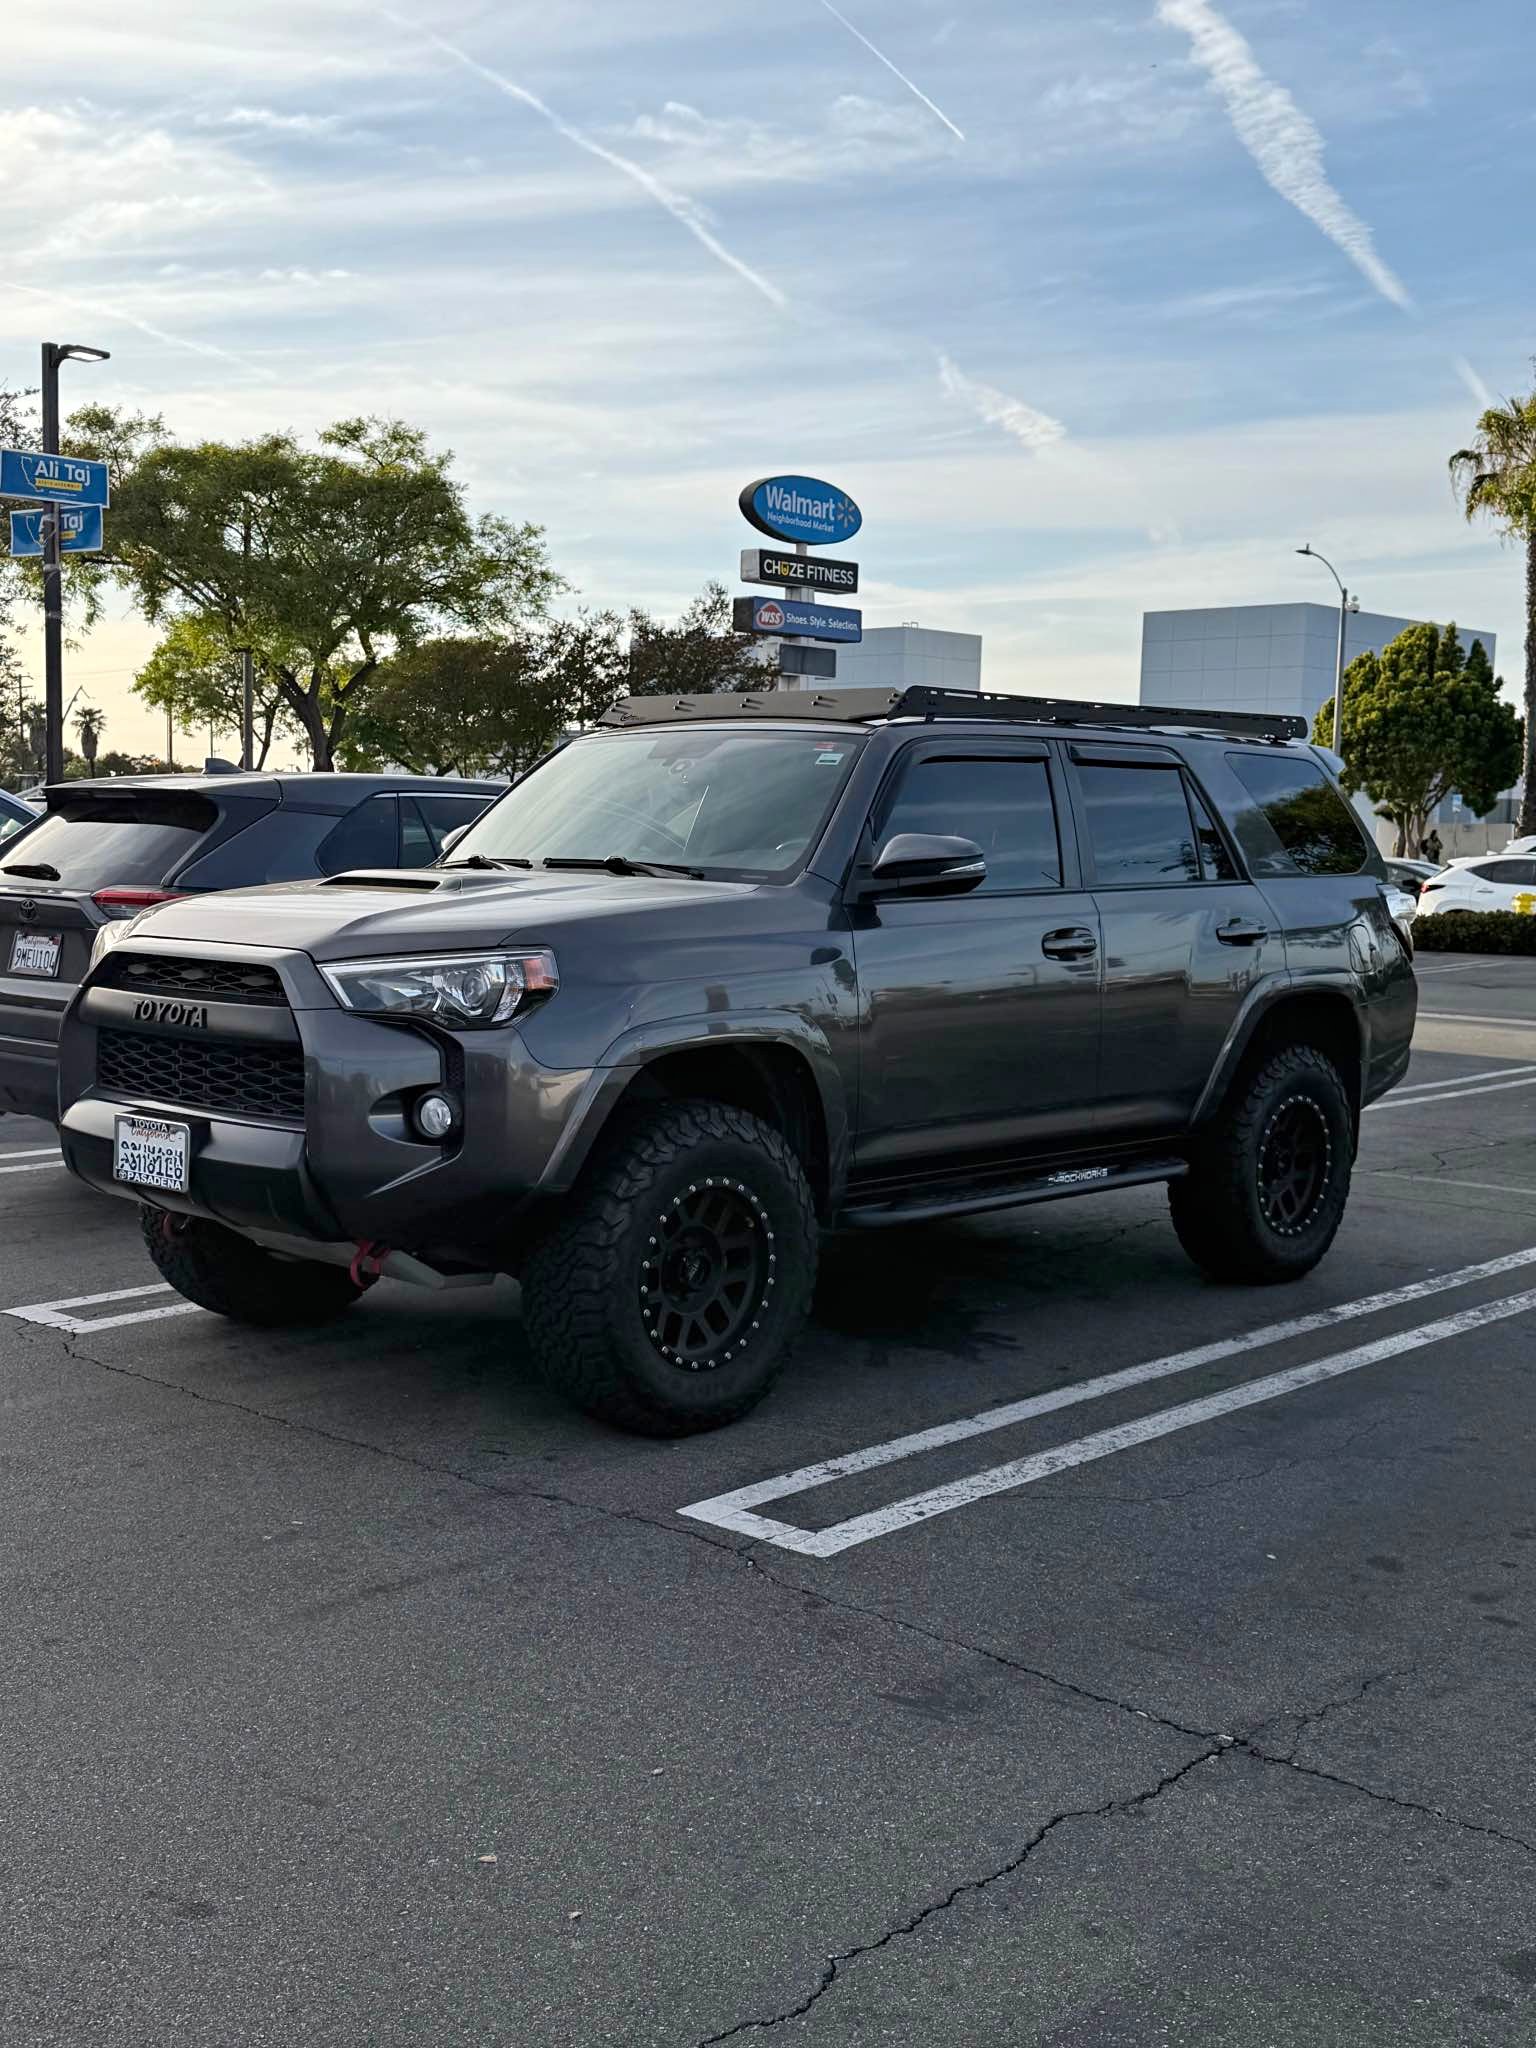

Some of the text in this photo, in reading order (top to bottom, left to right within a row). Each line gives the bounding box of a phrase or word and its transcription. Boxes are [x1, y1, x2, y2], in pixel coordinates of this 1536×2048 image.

[34, 461, 59, 479] Ali
[64, 463, 91, 487] Taj
[766, 485, 835, 520] Walmart
[61, 511, 84, 532] Taj
[767, 512, 835, 533] Neighborhood Market
[763, 558, 854, 585] CHUZE FITNESS
[760, 609, 781, 626] WSS
[15, 948, 55, 970] 9MEU104
[131, 999, 208, 1028] TOYOTA
[134, 1118, 168, 1133] TOYOTA
[128, 1171, 182, 1190] PASADENA
